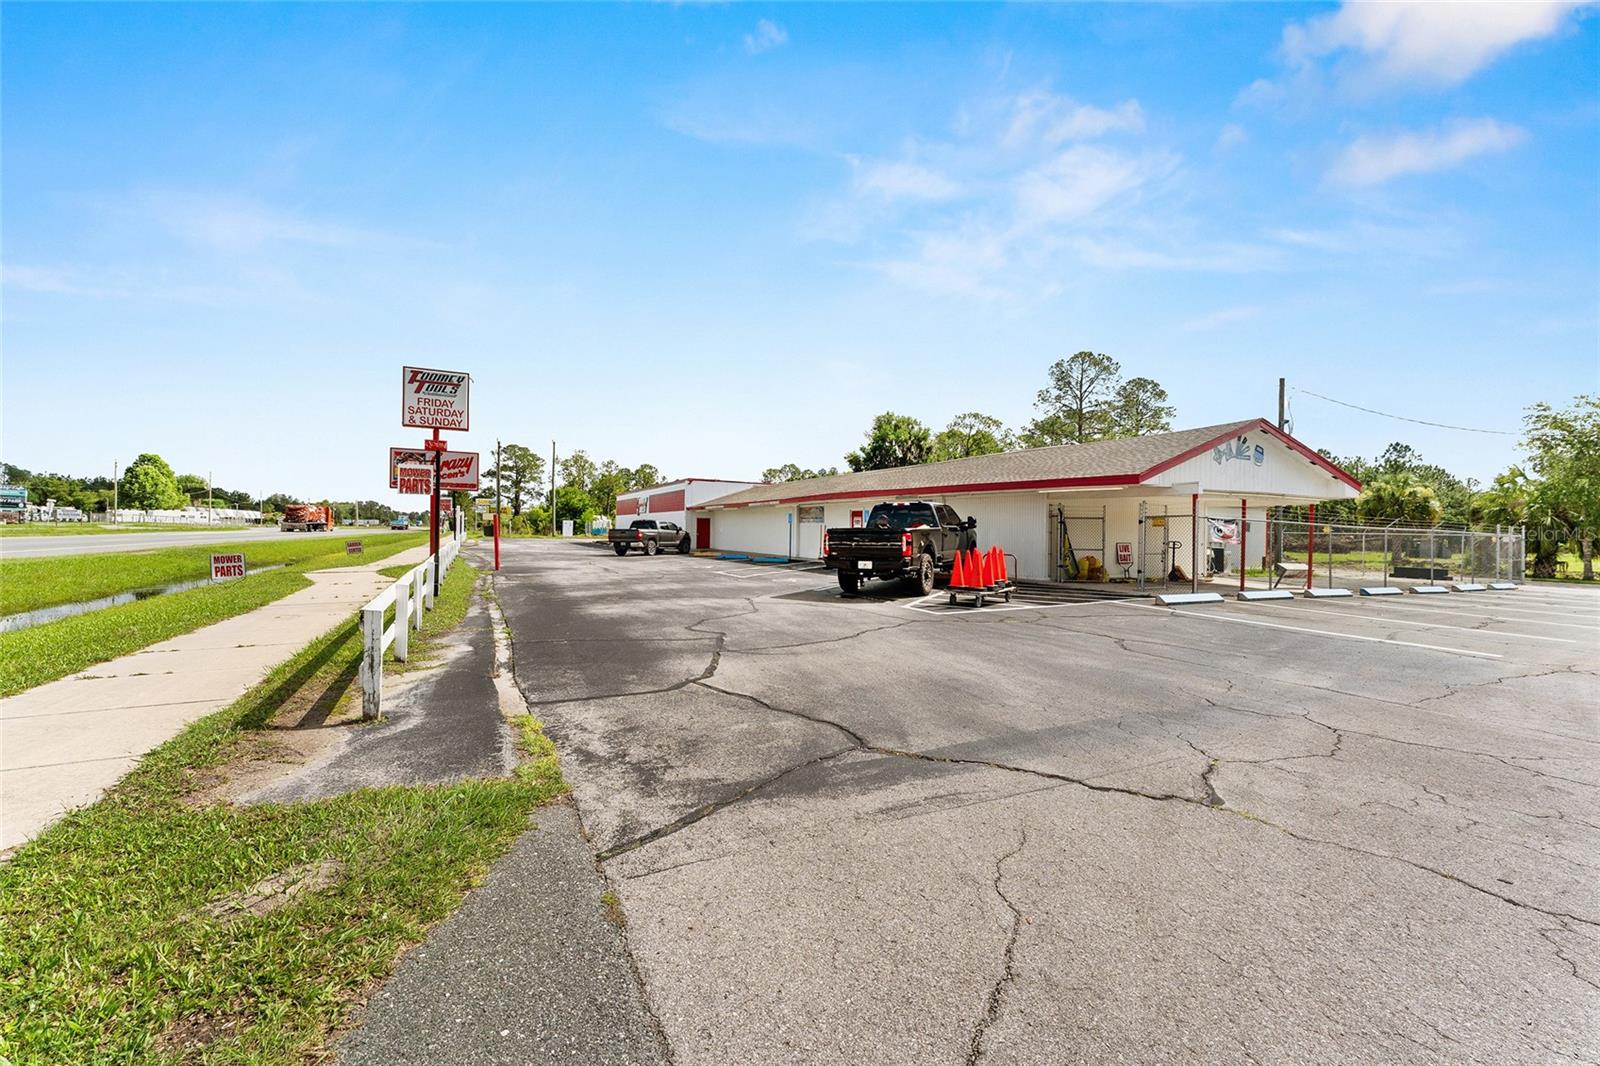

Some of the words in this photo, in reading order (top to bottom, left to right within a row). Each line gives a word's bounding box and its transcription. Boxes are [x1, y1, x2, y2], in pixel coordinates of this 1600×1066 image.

[417, 397, 455, 409] FRIDAY
[408, 406, 464, 418] SATURDAY
[408, 415, 416, 425] &
[419, 416, 463, 427] SUNDAY
[400, 467, 431, 479] MOWER
[400, 478, 431, 495] PARTS
[213, 555, 242, 565] MOWER
[214, 565, 243, 577] PARTS
